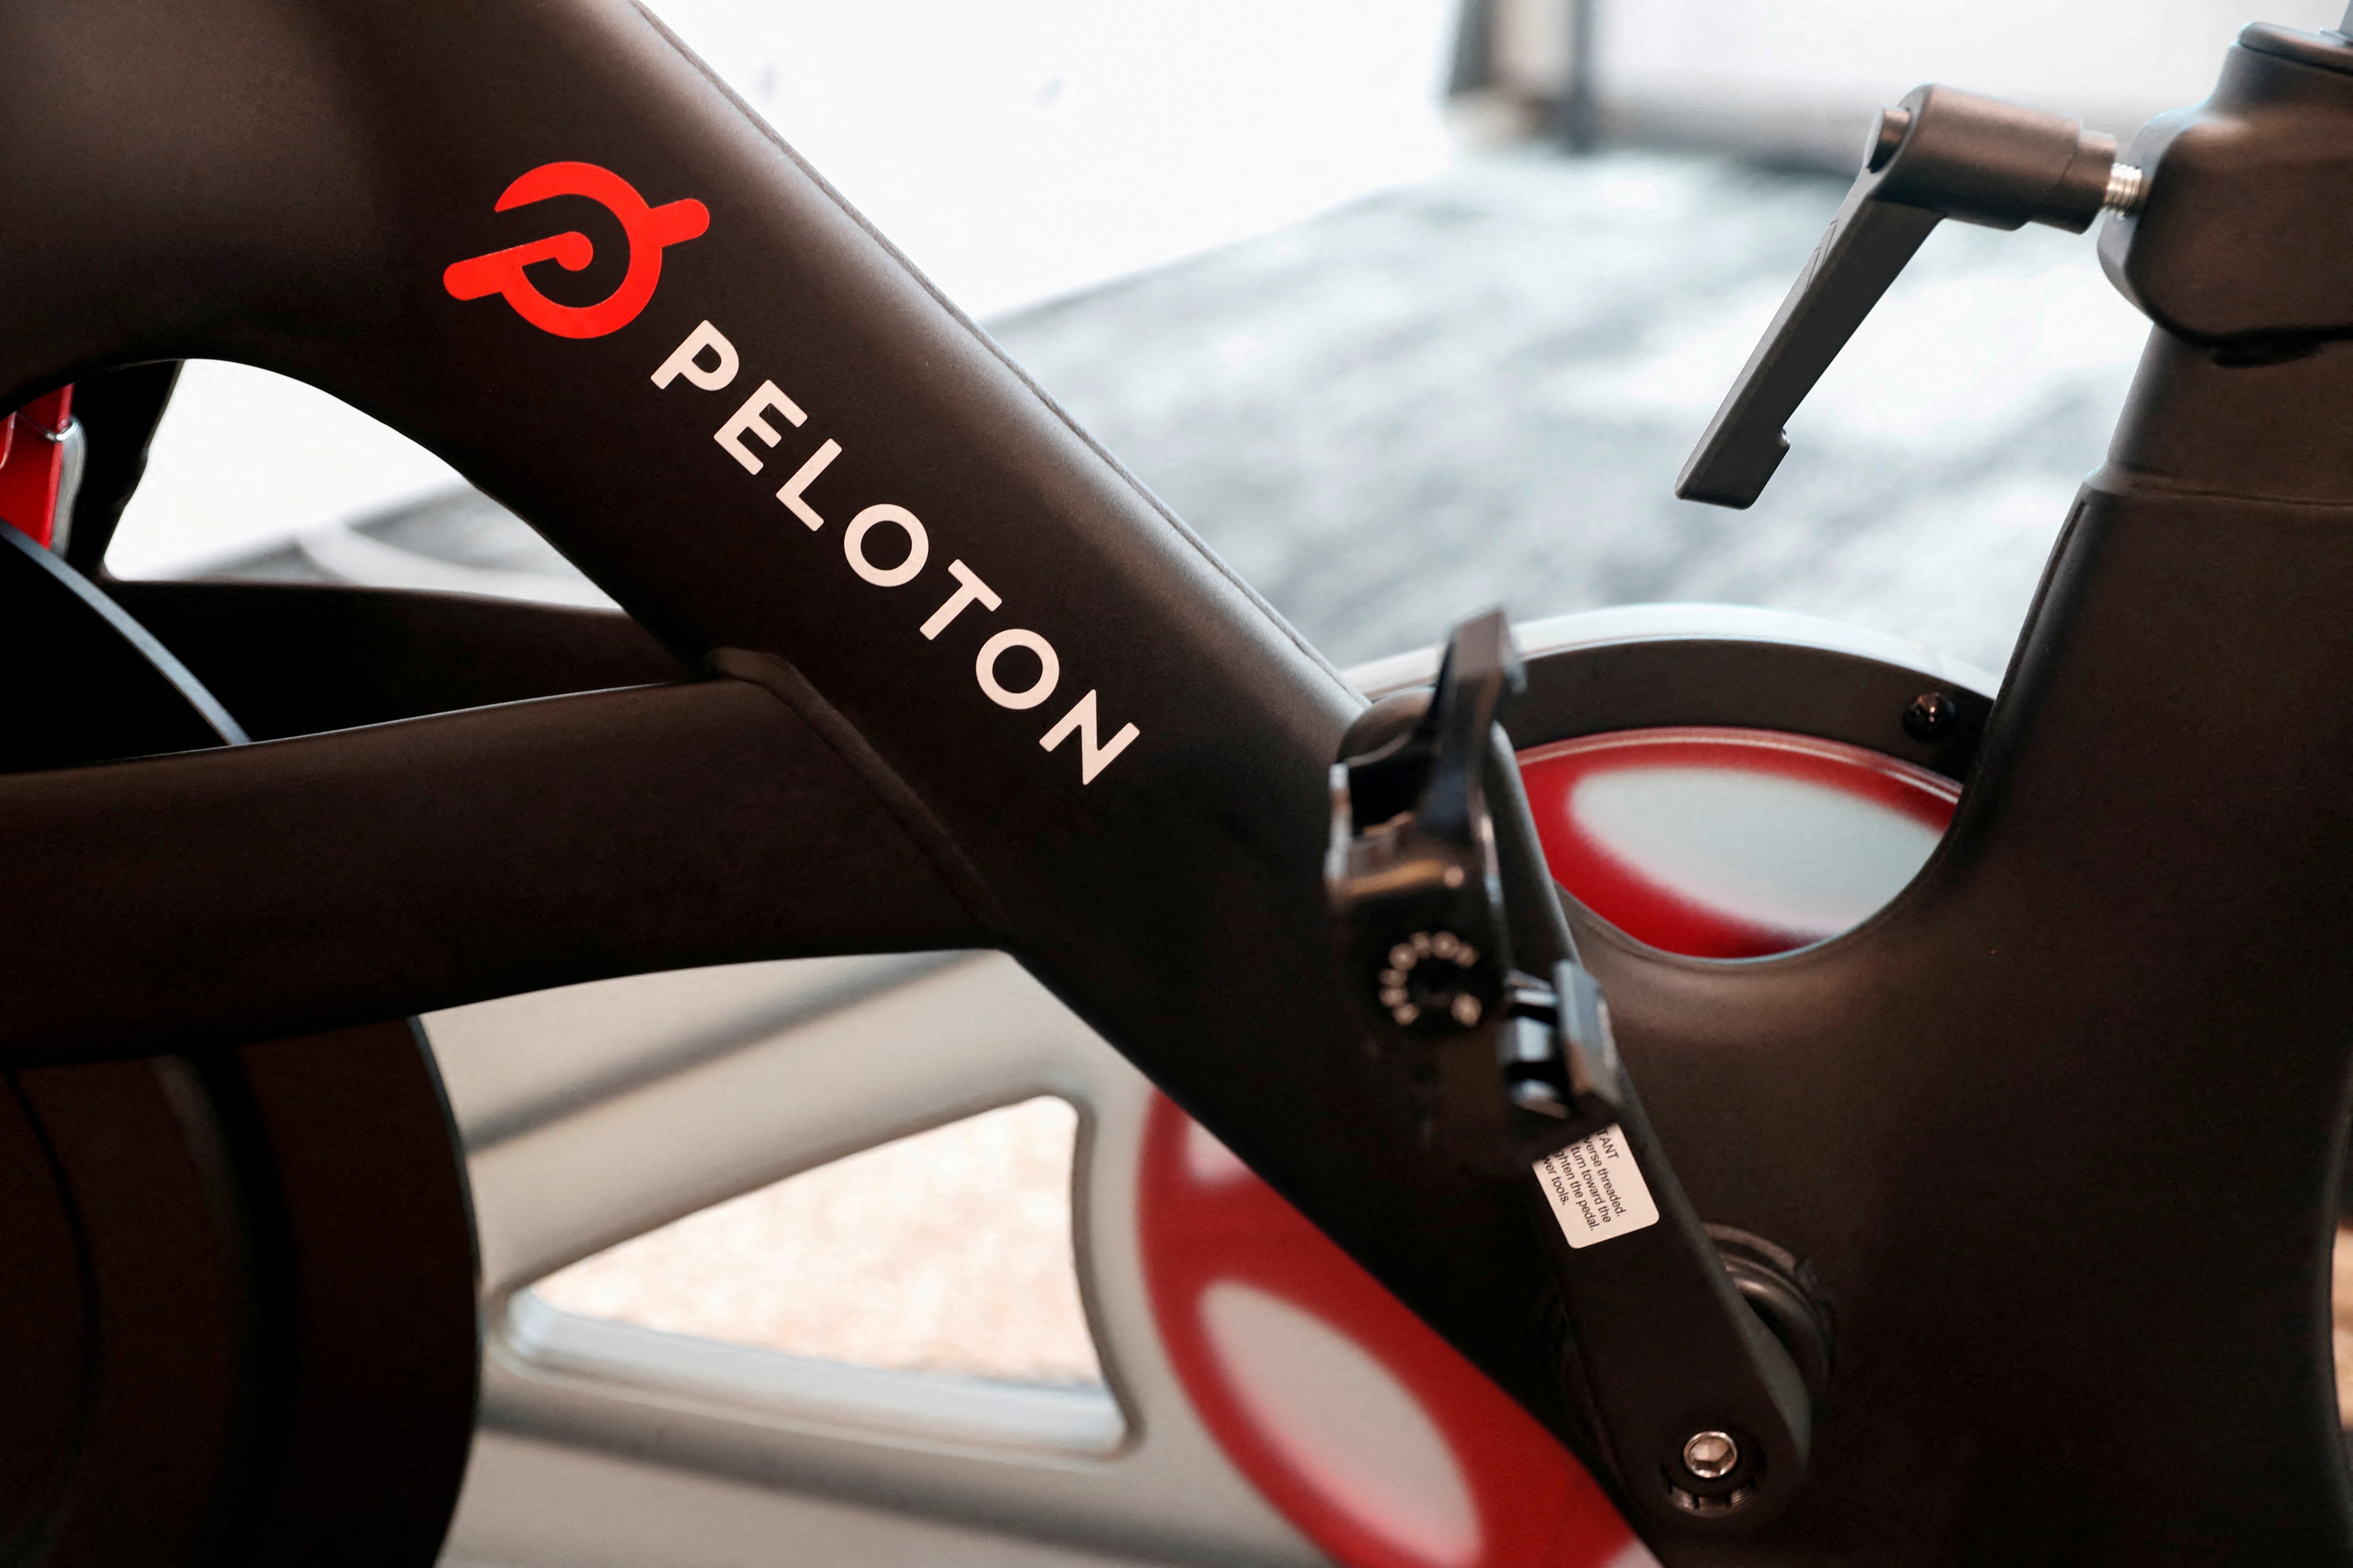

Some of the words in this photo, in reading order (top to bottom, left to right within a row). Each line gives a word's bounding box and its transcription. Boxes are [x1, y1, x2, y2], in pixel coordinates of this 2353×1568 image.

[651, 320, 1140, 785] PELOTON
[1596, 1129, 1619, 1158] TANT
[1552, 1176, 1569, 1205] tools.
[1570, 1181, 1583, 1198] the
[1577, 1200, 1600, 1231] pedal.
[1571, 1147, 1586, 1169] turn
[1582, 1170, 1604, 1205] toward
[1598, 1205, 1610, 1223] the
[1584, 1137, 1602, 1167] verse
[1598, 1167, 1626, 1217] threaded.
